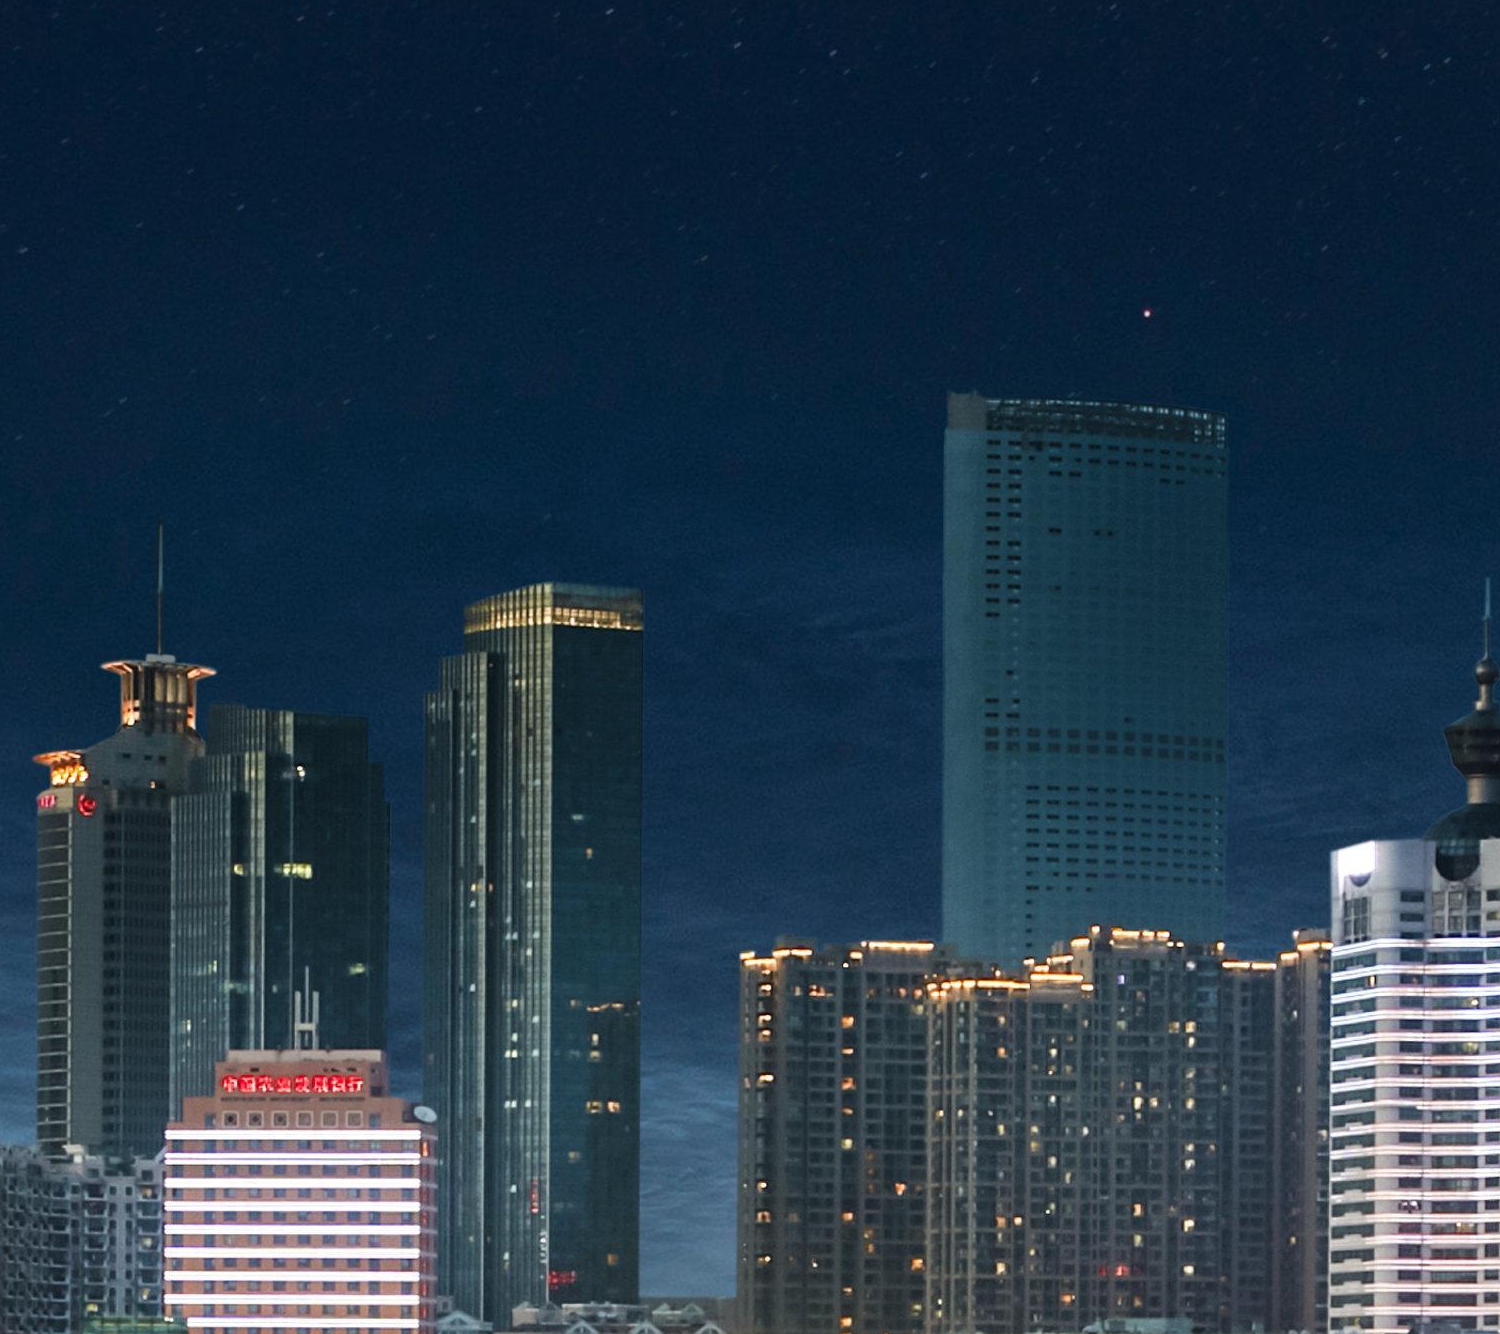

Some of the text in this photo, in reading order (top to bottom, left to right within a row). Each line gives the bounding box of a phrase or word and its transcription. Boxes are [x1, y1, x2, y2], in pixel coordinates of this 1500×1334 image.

[223, 1075, 363, 1093] 中国农业发展银行
